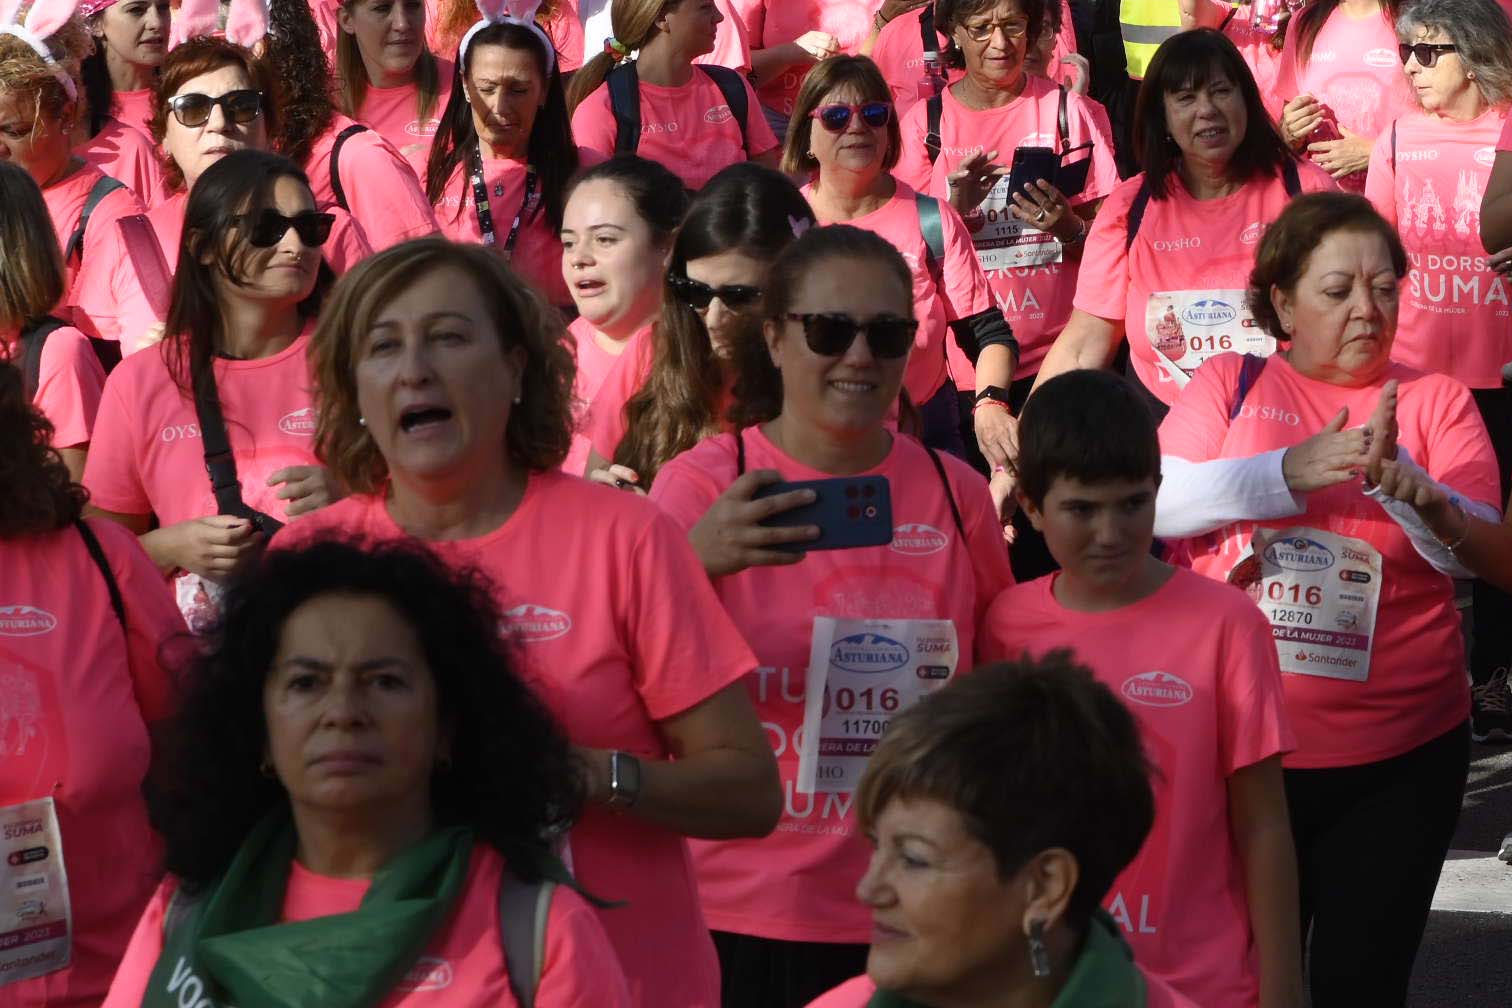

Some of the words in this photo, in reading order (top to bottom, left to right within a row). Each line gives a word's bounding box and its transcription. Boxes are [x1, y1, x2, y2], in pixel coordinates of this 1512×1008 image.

[1154, 236, 1200, 252] OYSHO
[1409, 269, 1508, 306] SUMA
[1186, 310, 1233, 321] ASTURIANA
[1190, 335, 1232, 351] 016
[1268, 550, 1330, 567] ASTURIANA
[1267, 581, 1324, 605] 016
[1271, 608, 1313, 625] 12870
[1272, 628, 1285, 637] DE
[1287, 629, 1299, 639] LA
[1300, 631, 1333, 643] MUJER
[833, 647, 904, 665] ASTURIANA
[1308, 652, 1358, 668] Santander
[835, 687, 900, 712] 016
[1127, 682, 1190, 700] ASTURIANA
[845, 743, 860, 753] DE
[4, 821, 44, 841] SUMA
